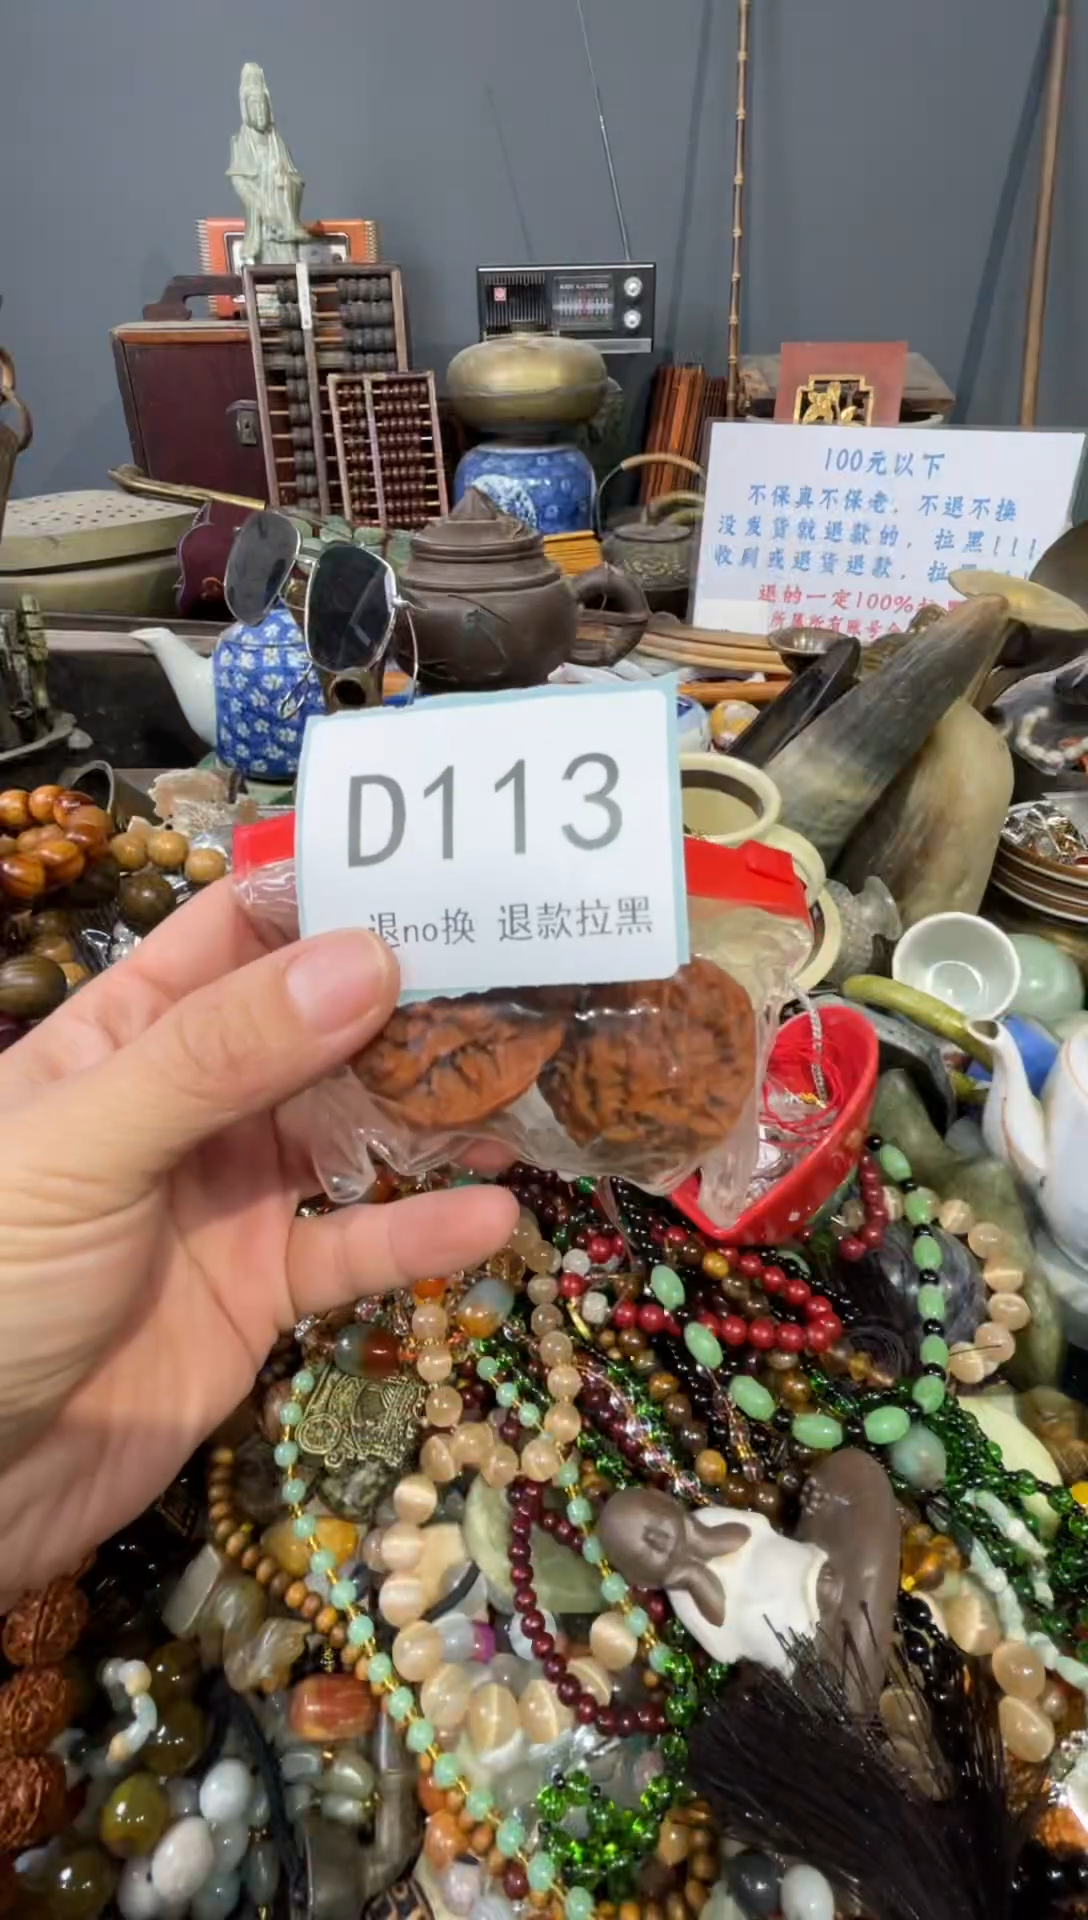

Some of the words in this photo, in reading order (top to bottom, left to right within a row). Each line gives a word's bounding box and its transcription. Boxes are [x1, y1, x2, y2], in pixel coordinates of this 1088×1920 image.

[824, 447, 945, 480] 100元以下
[347, 752, 623, 868] D113
[497, 895, 654, 943] 退款拉黑
